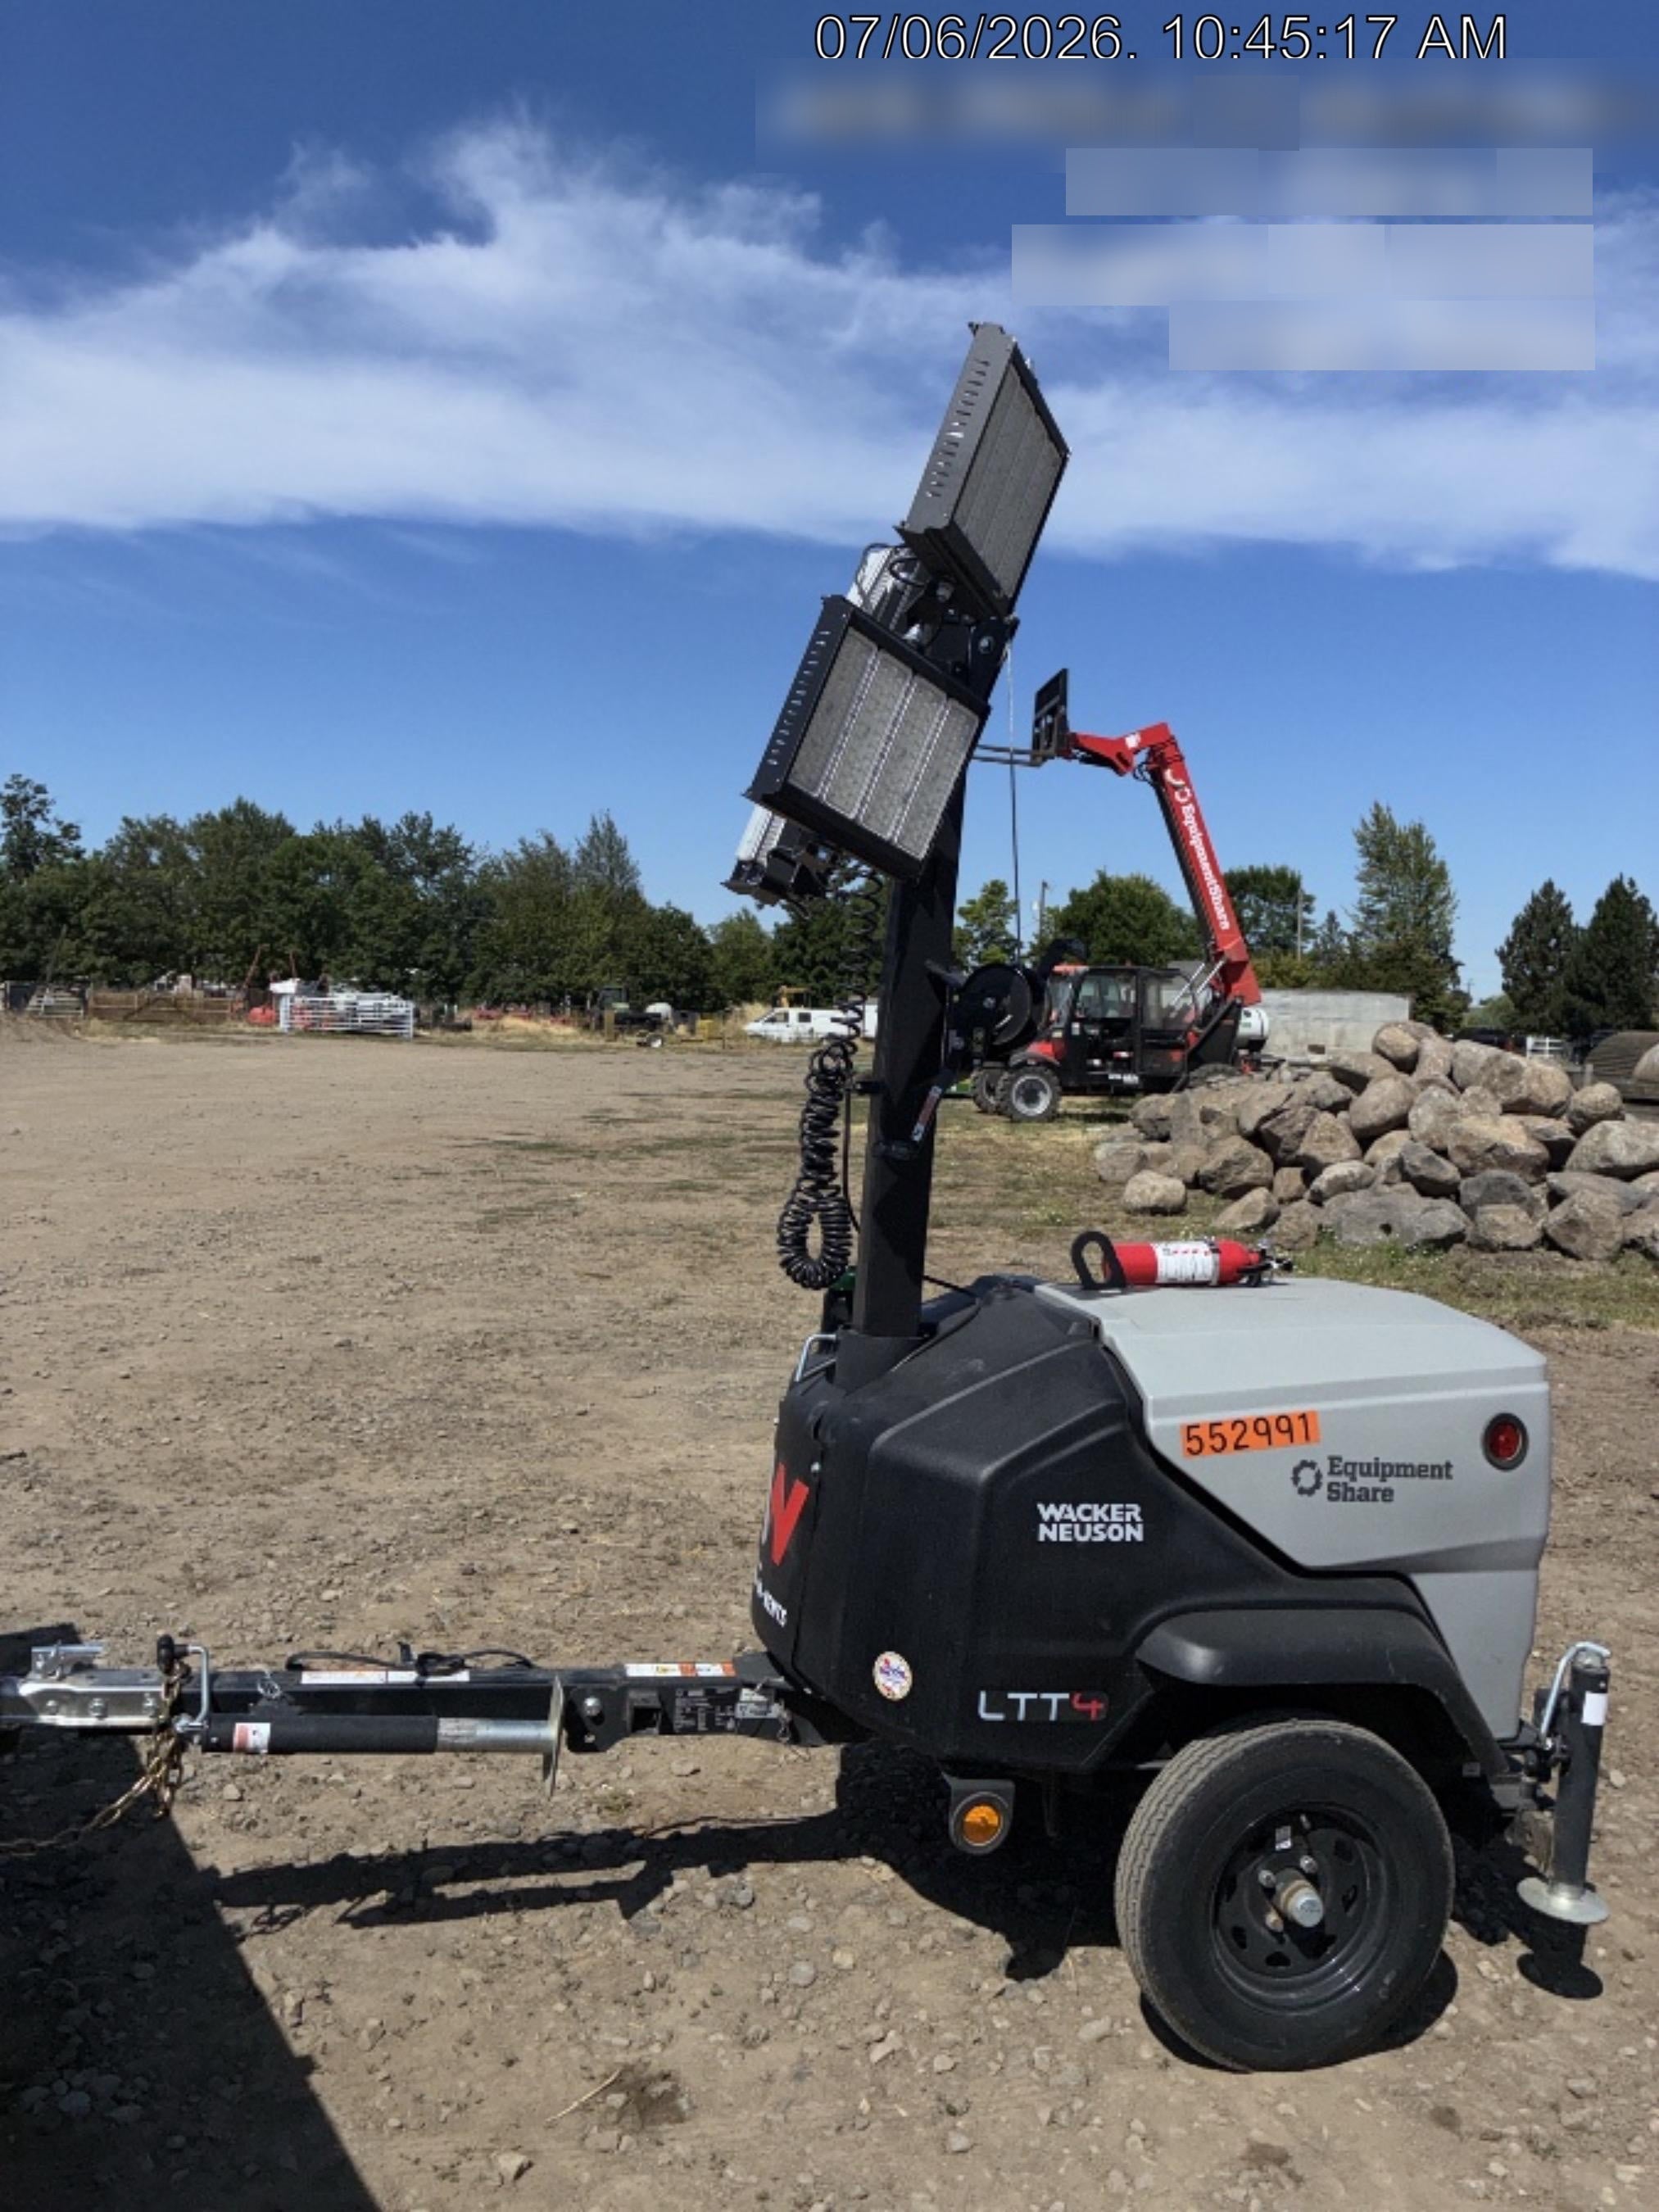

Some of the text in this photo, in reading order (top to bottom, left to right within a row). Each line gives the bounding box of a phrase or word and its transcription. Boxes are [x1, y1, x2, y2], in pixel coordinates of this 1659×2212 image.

[1185, 1412, 1312, 1456] 552991
[1326, 1455, 1454, 1482] Equipment
[1326, 1481, 1395, 1503] Share
[1036, 1503, 1143, 1522] WACKER
[1038, 1523, 1144, 1542] NEUSON
[977, 1690, 1104, 1721] LTT4
